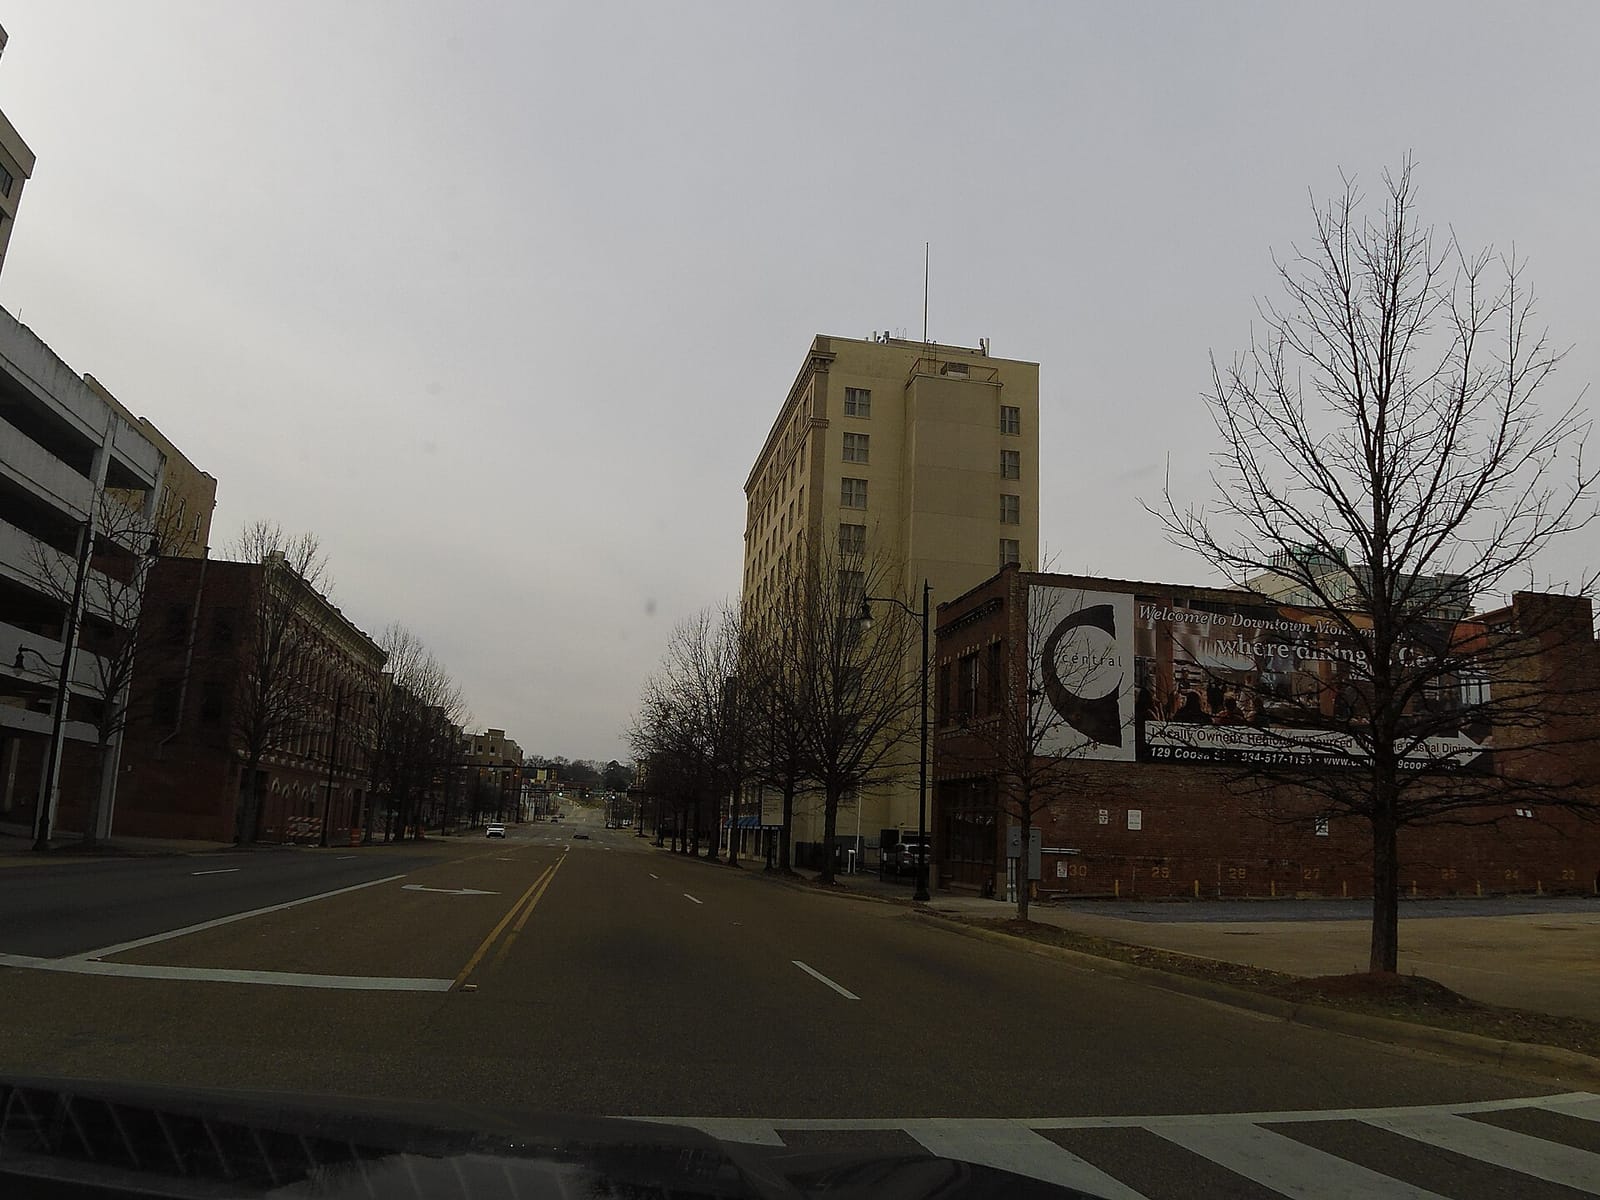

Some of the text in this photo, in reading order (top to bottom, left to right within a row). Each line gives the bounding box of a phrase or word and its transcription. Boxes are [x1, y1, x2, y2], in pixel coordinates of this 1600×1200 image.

[1139, 603, 1208, 624] Welcome
[1212, 612, 1227, 626] to
[1231, 612, 1311, 633] Downtown
[1216, 633, 1289, 659] where
[1062, 653, 1122, 667] central
[1151, 746, 1171, 759] 129
[1069, 865, 1088, 877] 30
[1303, 868, 1320, 880] 27
